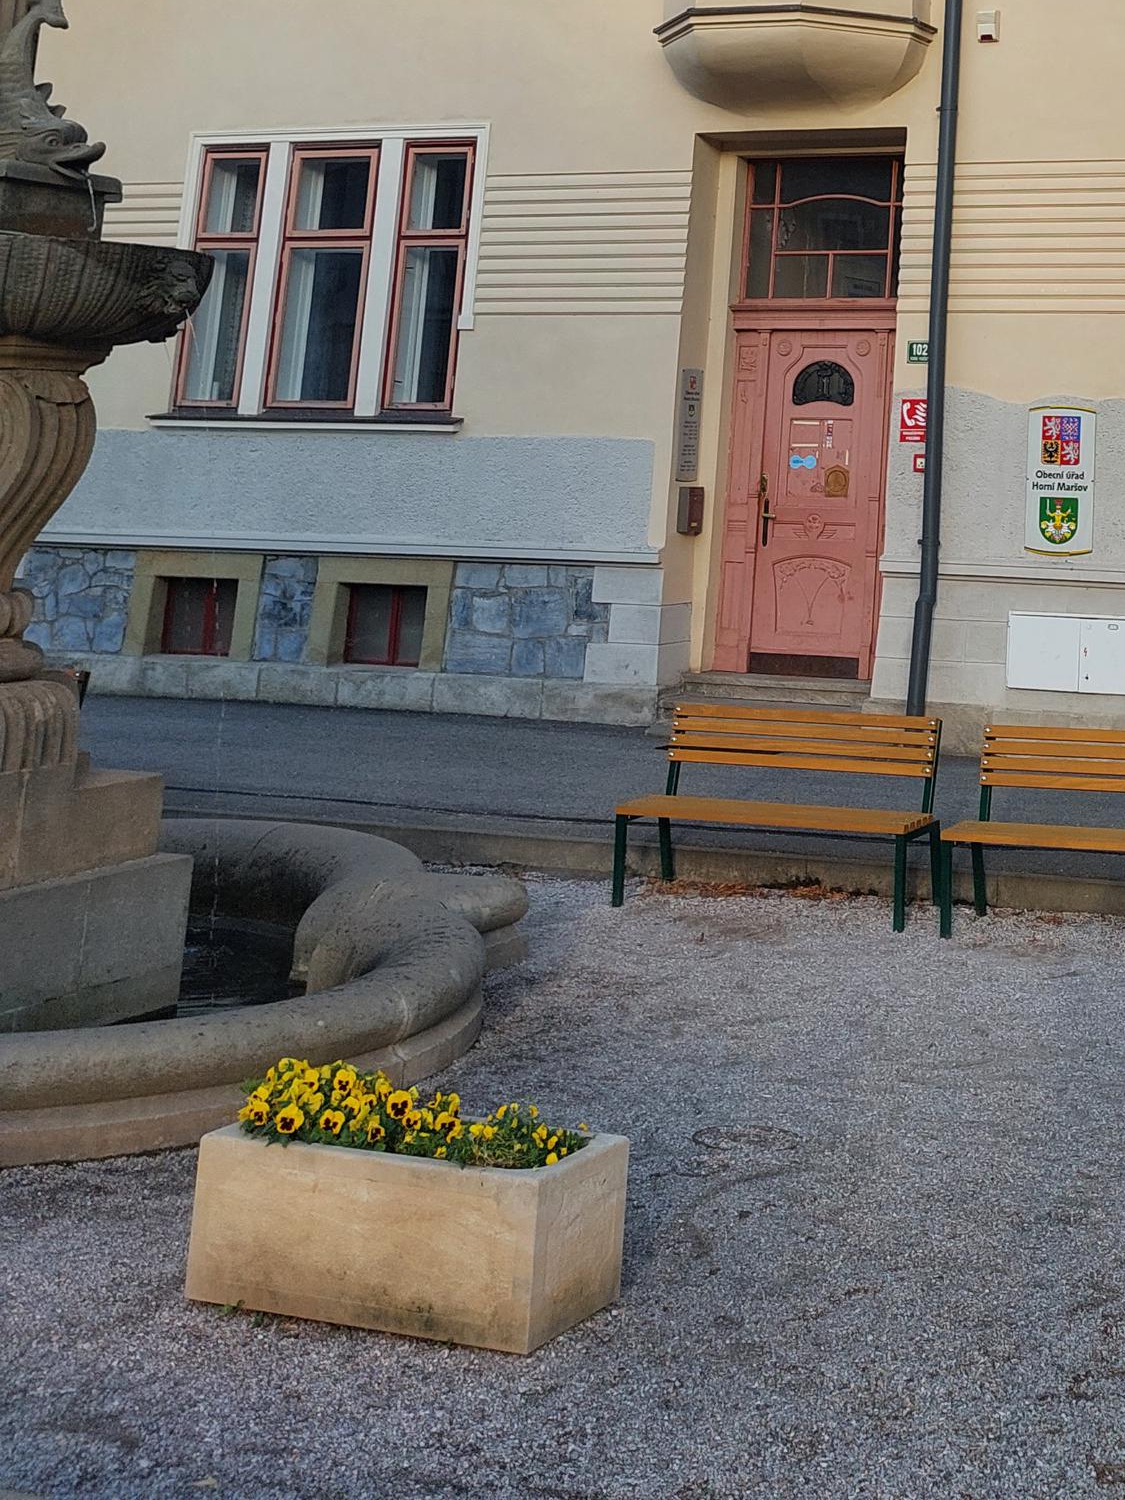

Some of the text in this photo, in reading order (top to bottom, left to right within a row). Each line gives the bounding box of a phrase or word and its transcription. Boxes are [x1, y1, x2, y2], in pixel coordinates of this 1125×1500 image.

[912, 343, 928, 356] 102
[1035, 470, 1085, 480] Obecní úřad
[1032, 481, 1088, 491] Horní Maršov
